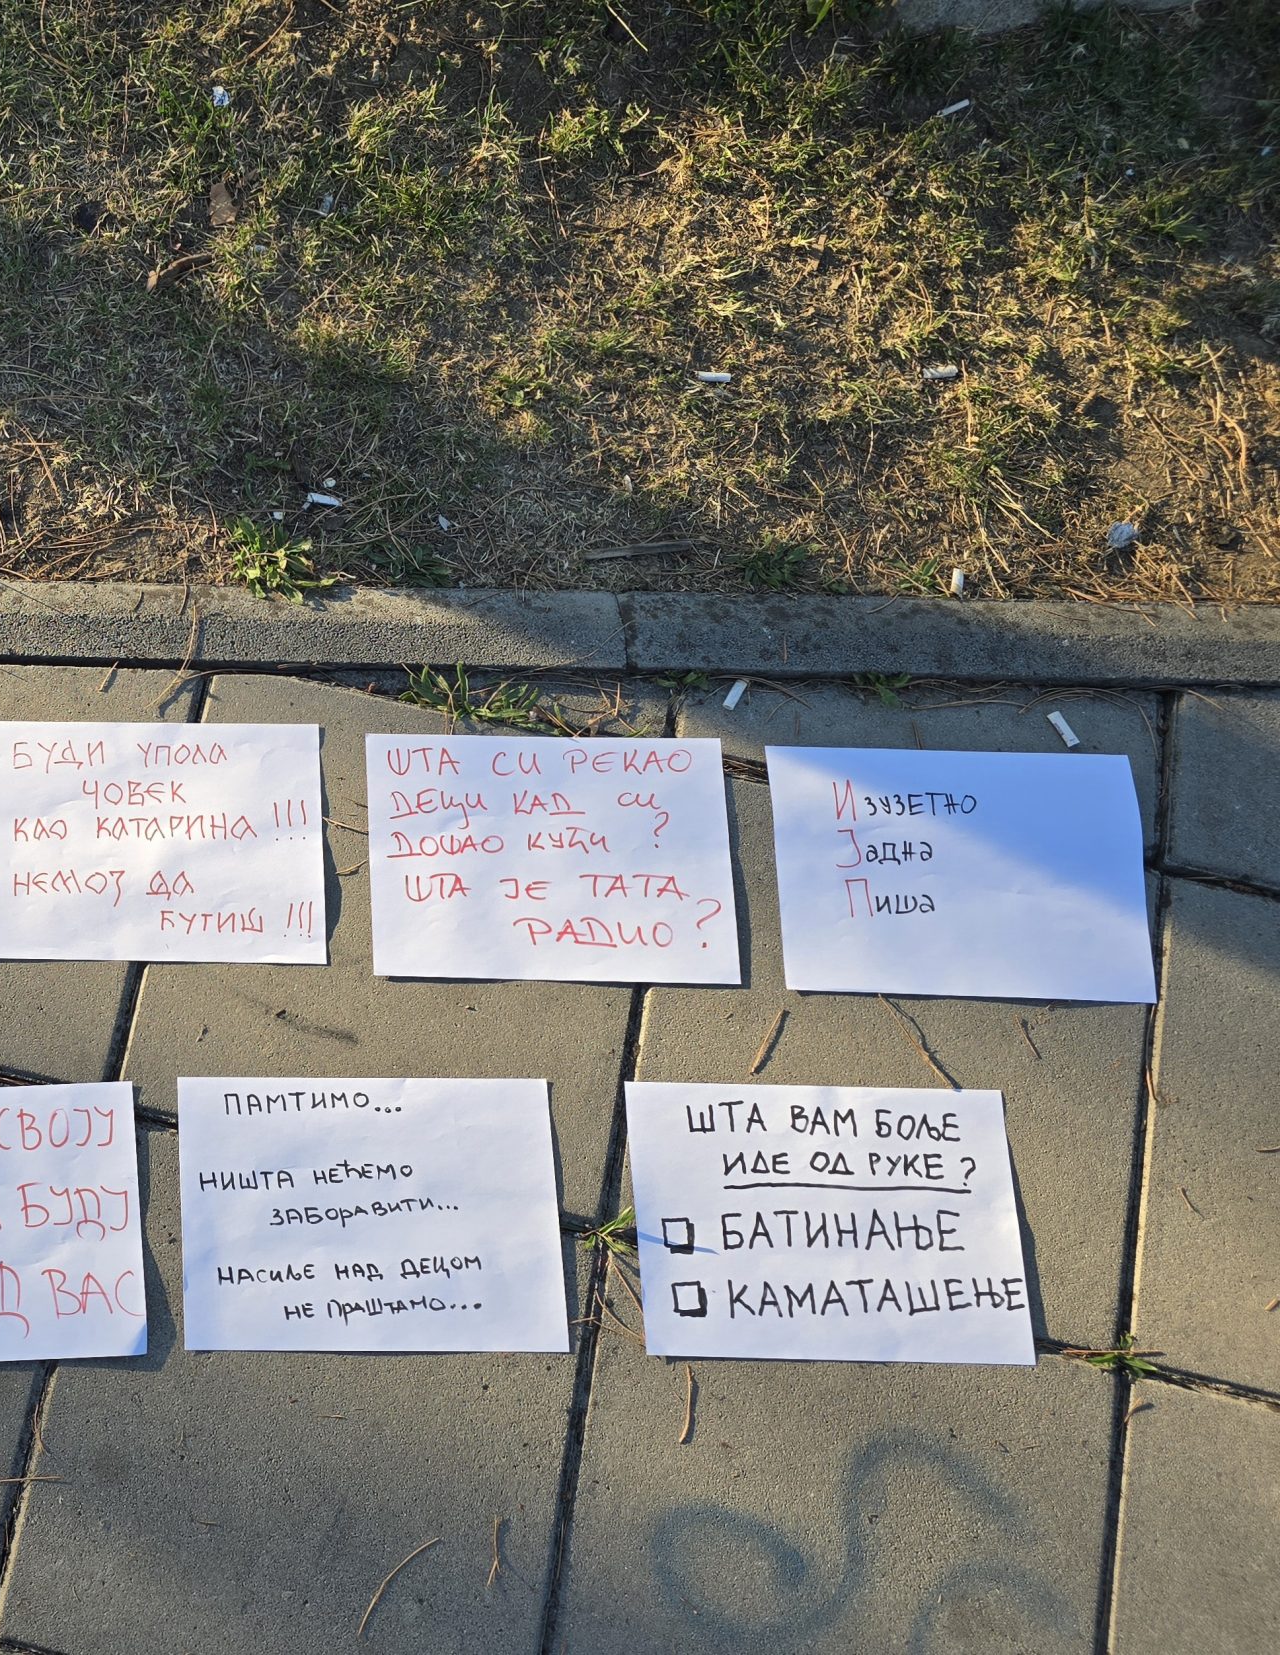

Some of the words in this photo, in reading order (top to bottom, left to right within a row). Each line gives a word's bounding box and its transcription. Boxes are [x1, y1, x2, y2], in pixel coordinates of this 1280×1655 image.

[13, 740, 105, 774] БУДИ
[137, 742, 228, 768] УПОЛА
[387, 747, 460, 776] ШТА
[562, 748, 693, 775] РЕКАО
[13, 817, 67, 842] КАО
[96, 812, 257, 841] КАТАРИНА
[145, 870, 194, 901] ДА
[405, 873, 471, 902] ШТА
[579, 873, 690, 900] ТАТА
[686, 1100, 767, 1133] ШТА
[790, 1104, 858, 1138] ВАМ
[875, 1108, 961, 1142] БОЉЕ
[199, 1169, 295, 1192] НИШТА
[313, 1159, 414, 1185] НЕЋЕМО
[722, 1151, 791, 1175] ИДЕ
[809, 1151, 855, 1176] ОД
[17, 1181, 129, 1242] БУДУ
[720, 1208, 966, 1252] БАТИНАЊЕ
[335, 1263, 384, 1282] НАД
[400, 1255, 483, 1280] ДЕЦОМ
[41, 1268, 146, 1320] ВАС
[727, 1277, 1027, 1319] КАМАТАШЕЊЕ
[284, 1302, 315, 1321] НЕ
